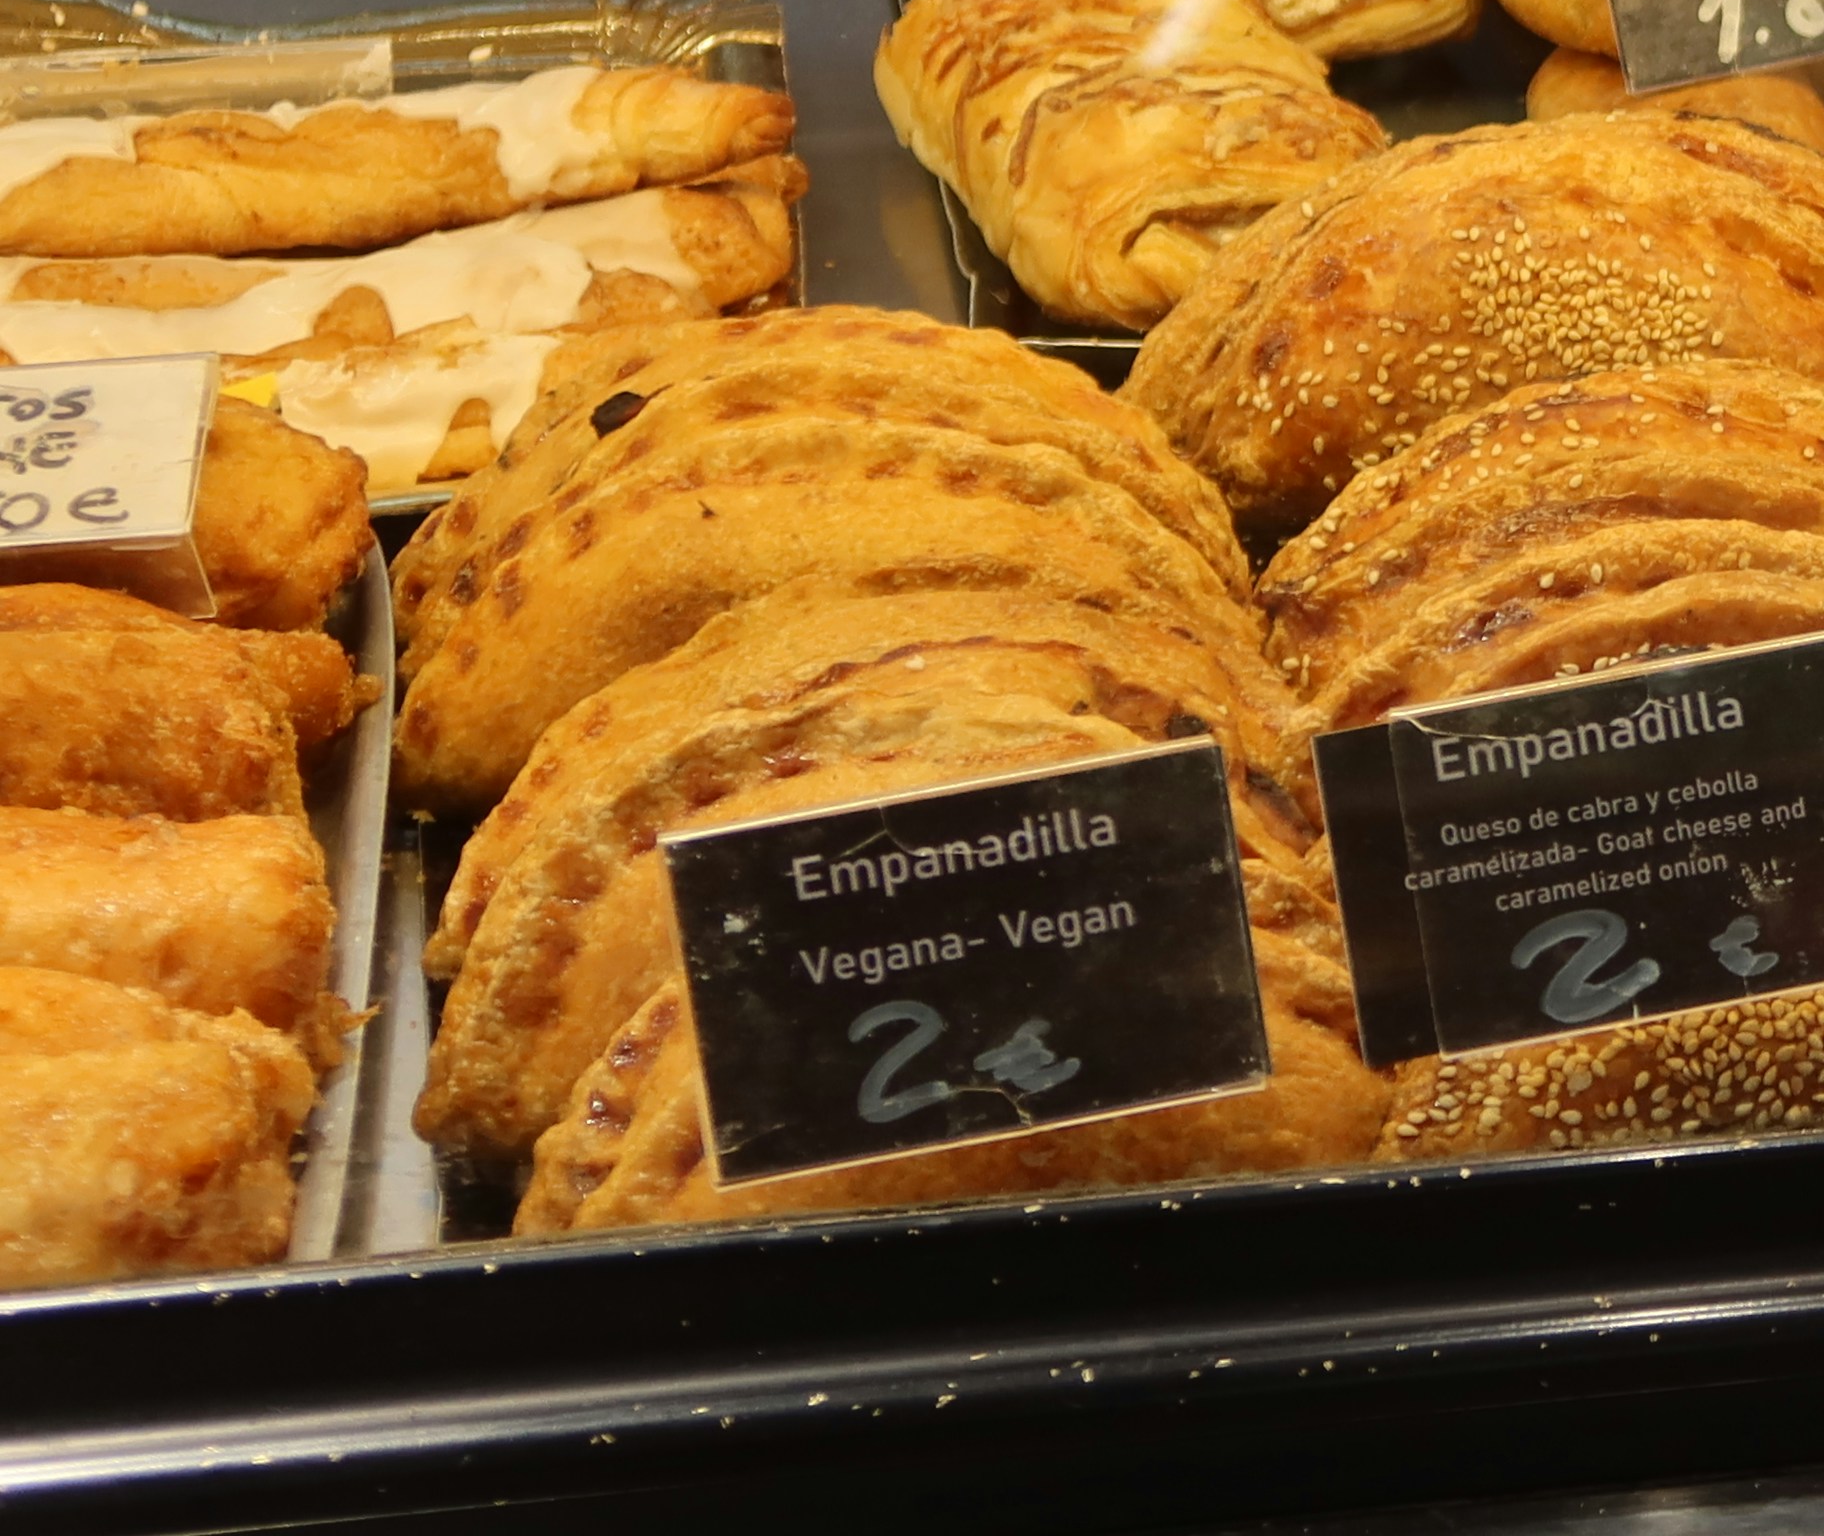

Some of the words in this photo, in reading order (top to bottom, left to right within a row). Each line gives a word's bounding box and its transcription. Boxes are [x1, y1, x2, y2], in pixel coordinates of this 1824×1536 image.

[1432, 691, 1745, 784] Empanadilla
[1403, 844, 1588, 892] caramelizada-
[1596, 827, 1655, 856] Goat
[1663, 809, 1753, 845] cheese
[1760, 796, 1808, 825] and
[1440, 817, 1522, 847] Queso
[1529, 807, 1560, 832] de
[1567, 794, 1640, 824] cabra
[1645, 790, 1661, 814] y
[1667, 769, 1760, 806] cebolla
[792, 809, 1121, 902] Empanadilla
[1495, 864, 1652, 912] caramelized
[1658, 851, 1729, 883] onion
[800, 929, 986, 986] Vegana-
[999, 899, 1138, 950] Vegan
[1510, 908, 1661, 1024] 2
[848, 999, 952, 1124] 2
